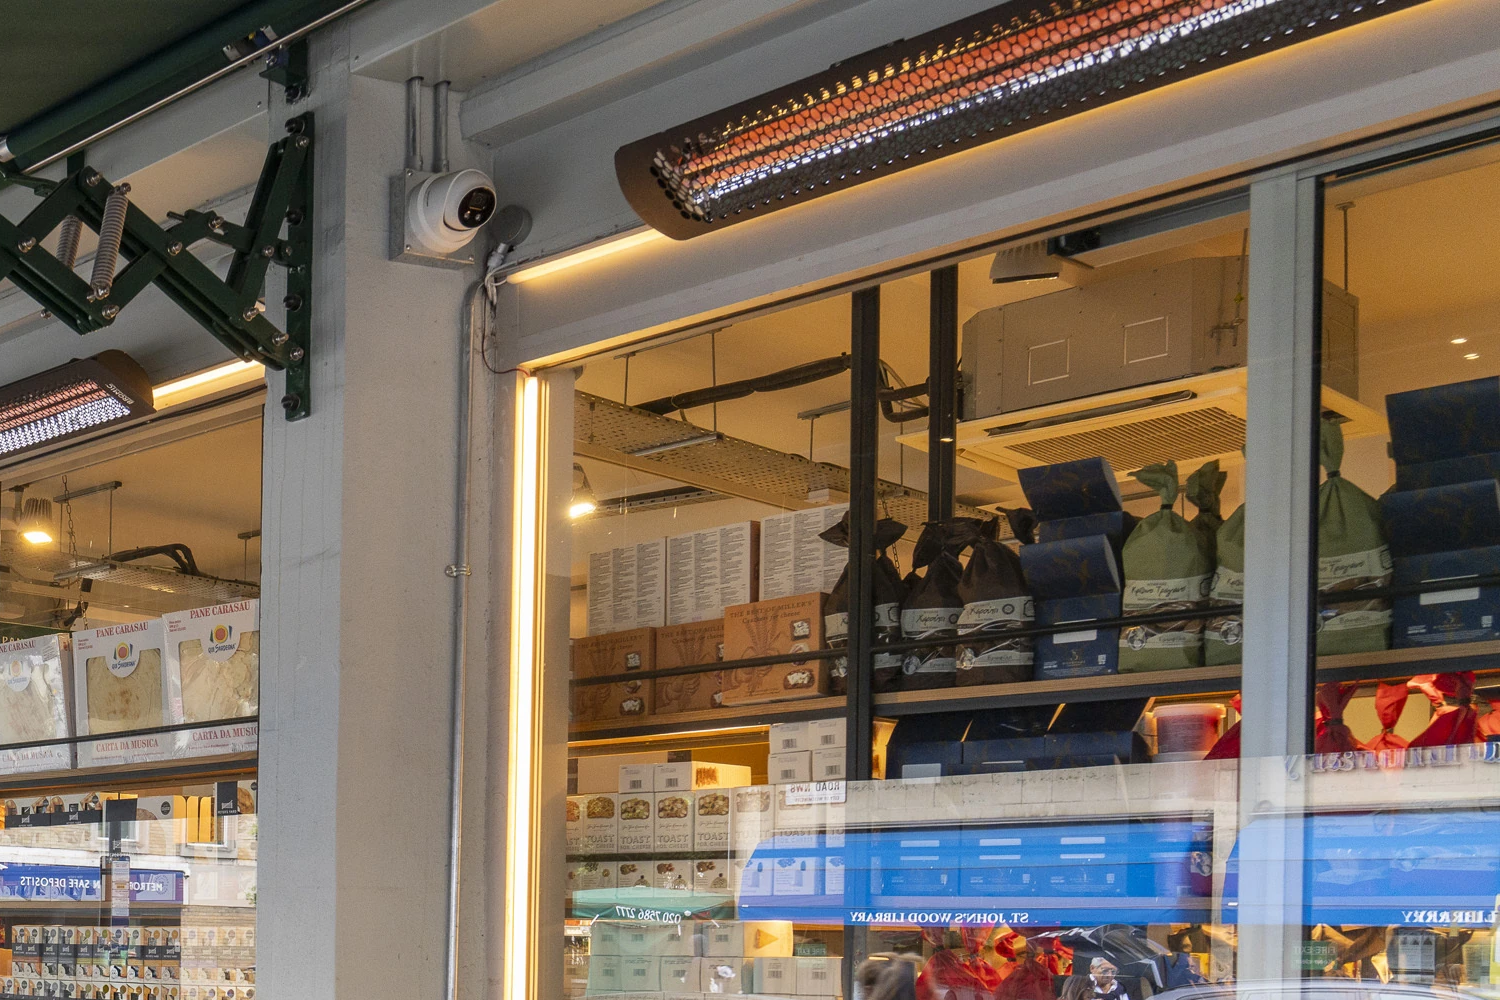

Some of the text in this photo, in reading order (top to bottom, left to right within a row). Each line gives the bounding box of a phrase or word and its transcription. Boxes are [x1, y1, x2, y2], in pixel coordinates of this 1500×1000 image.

[190, 600, 250, 620] PANE CARASAU
[730, 611, 744, 619] THE
[96, 621, 148, 638] PANE CARASAU
[8, 640, 36, 652] CARASAU
[192, 725, 258, 741] CARTA DA MUSIC
[96, 738, 159, 752] CARTA DA MUSICA
[21, 752, 30, 761] DA
[586, 834, 615, 843] TOAST
[620, 836, 651, 844] TOAST
[656, 834, 689, 843] TOAST
[698, 832, 730, 841] TOAST
